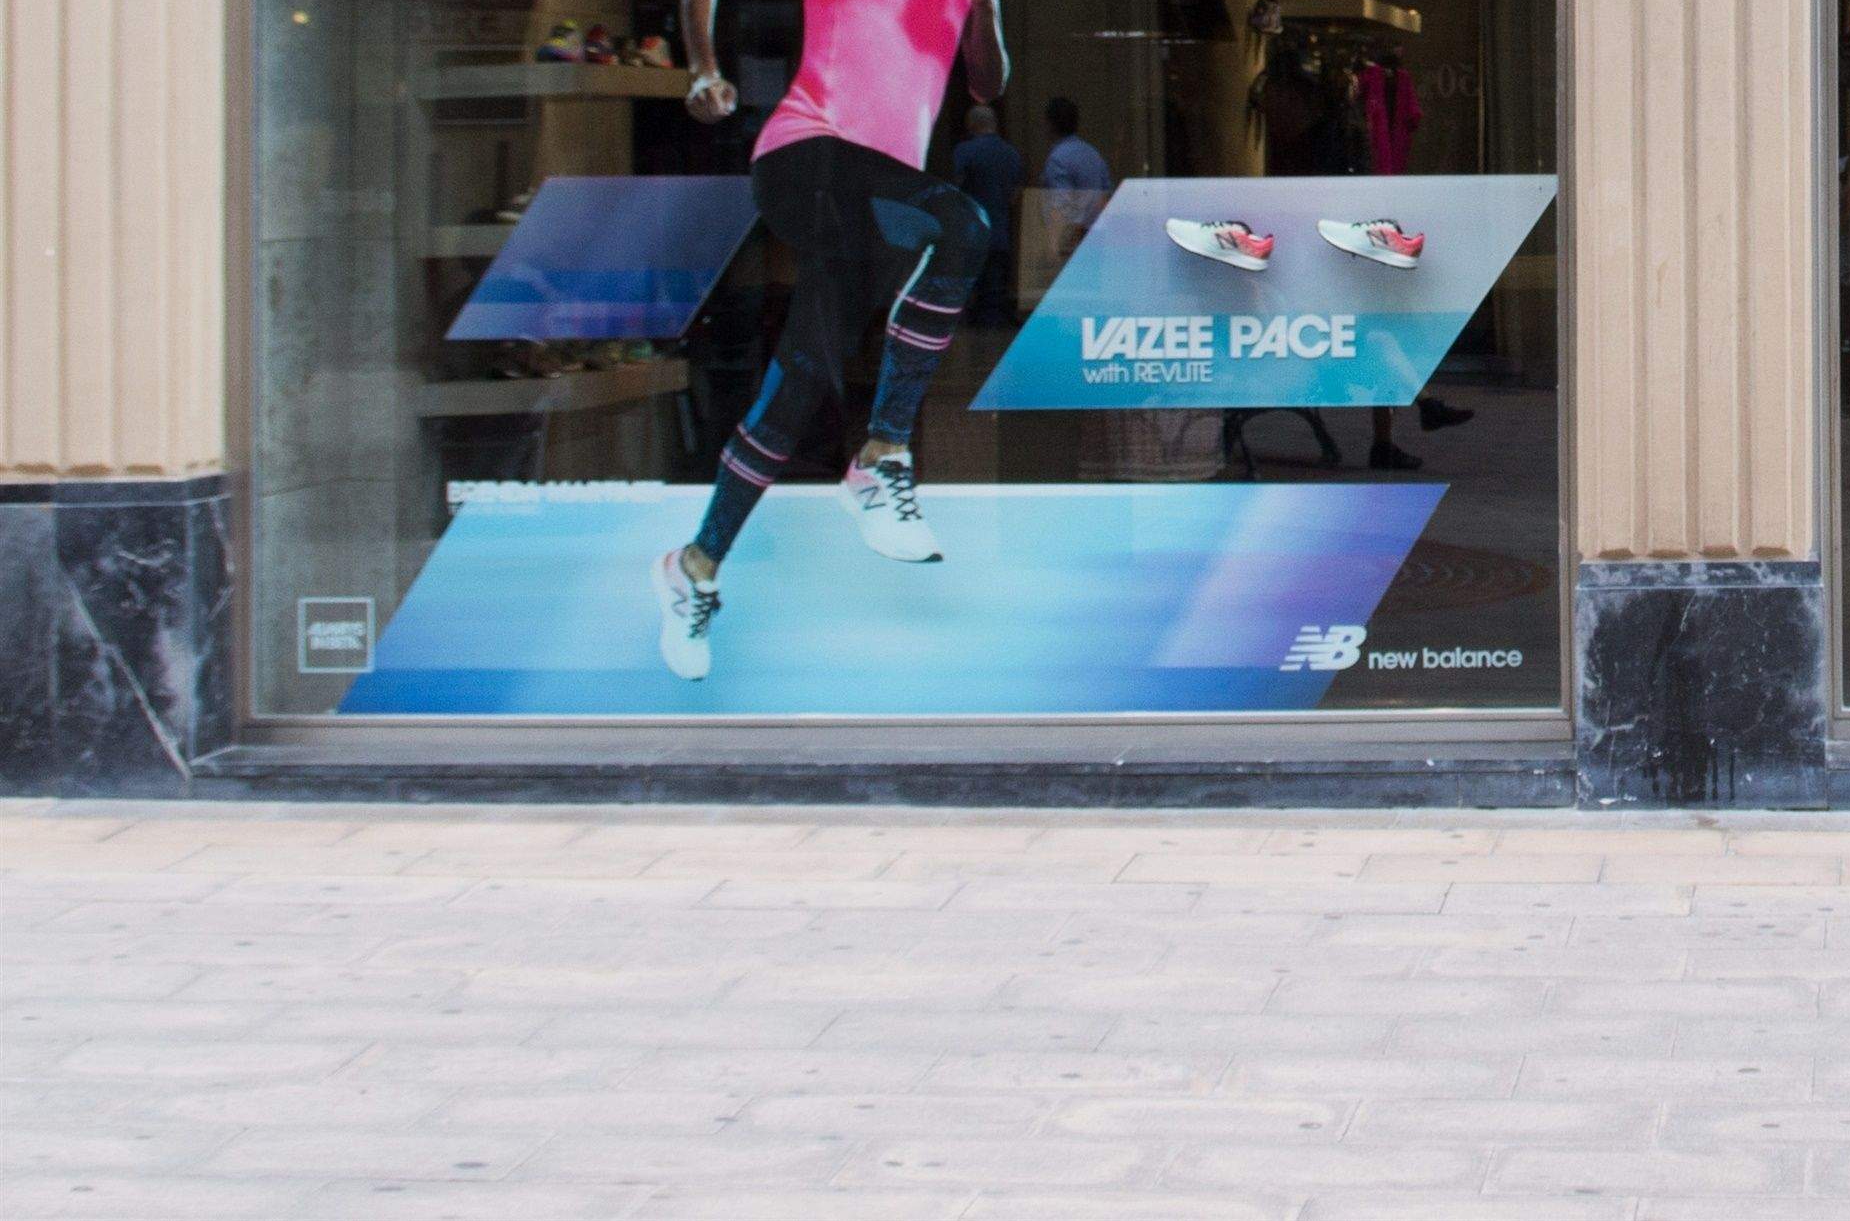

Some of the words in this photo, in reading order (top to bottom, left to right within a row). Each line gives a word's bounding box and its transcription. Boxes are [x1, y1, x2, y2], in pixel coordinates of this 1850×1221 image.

[1081, 316, 1214, 360] VAZEE
[1230, 314, 1357, 359] PACE
[1083, 363, 1129, 385] with
[1280, 626, 1367, 671] NB
[1368, 651, 1418, 669] new
[1422, 647, 1523, 669] balance
